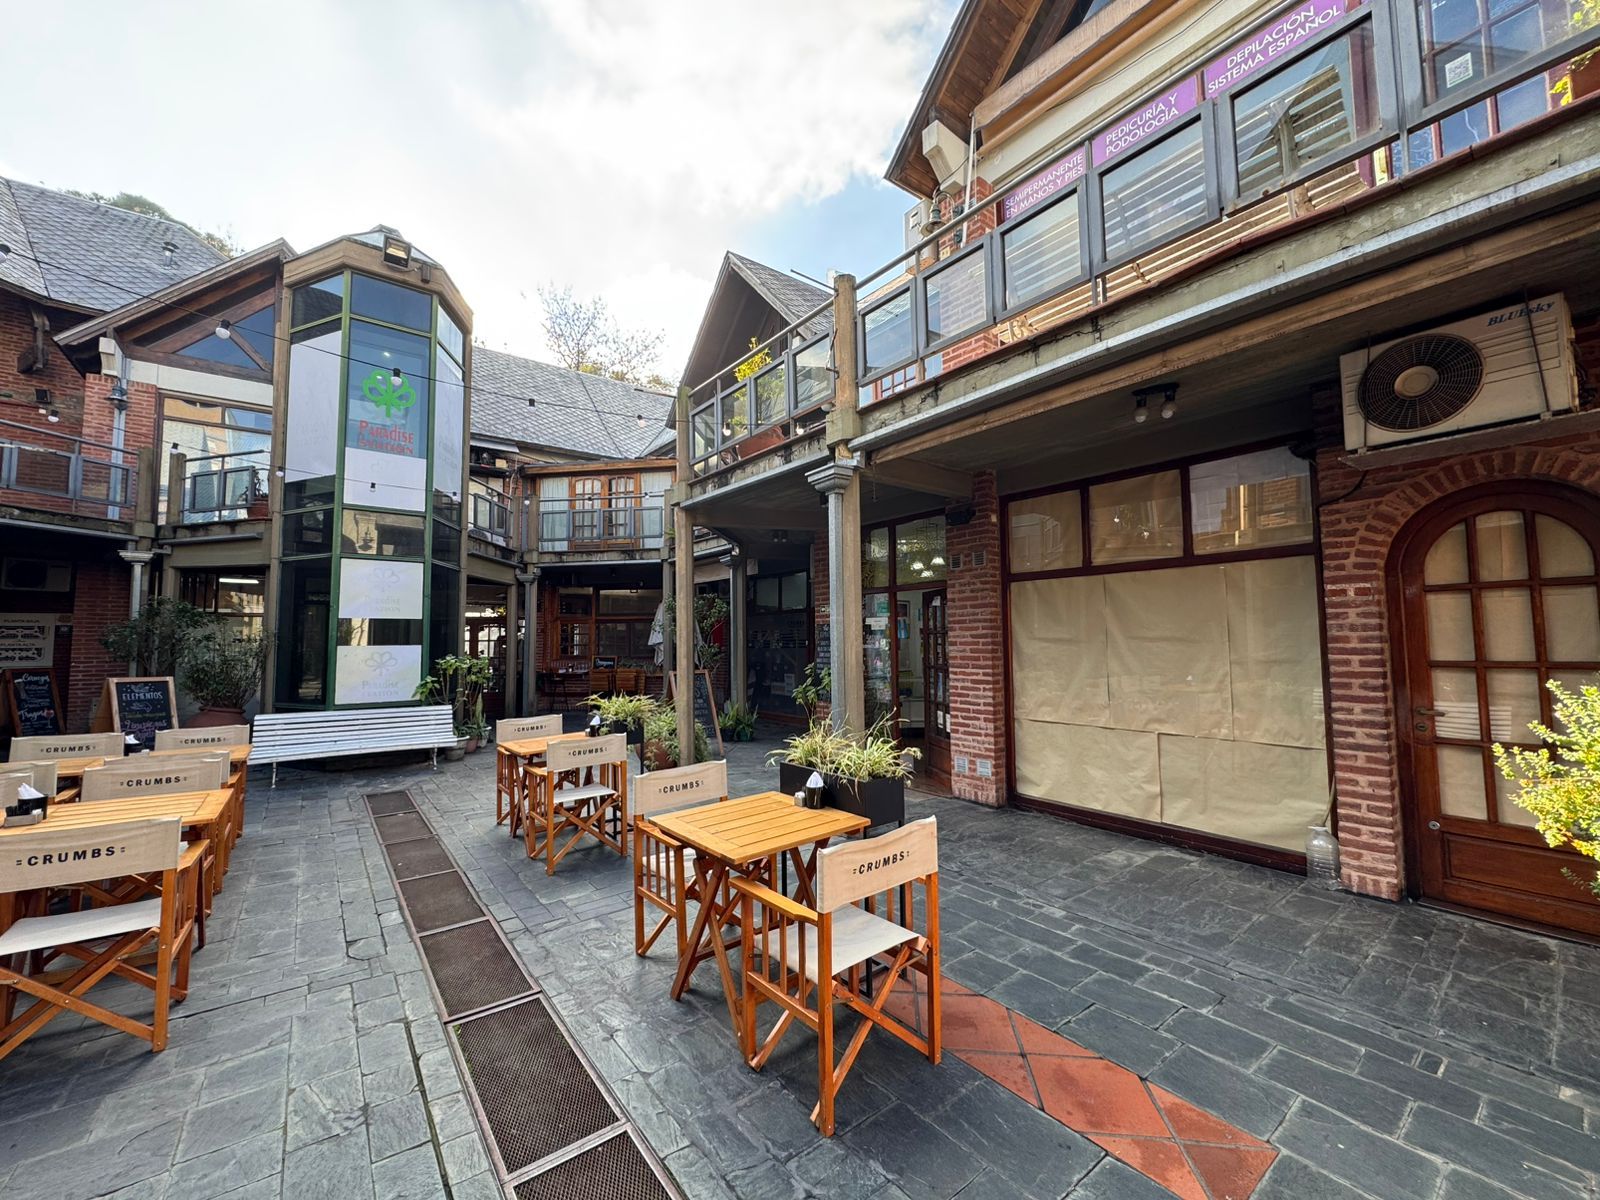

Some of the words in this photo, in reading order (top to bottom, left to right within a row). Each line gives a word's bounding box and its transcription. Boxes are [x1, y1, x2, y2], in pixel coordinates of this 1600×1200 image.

[1207, 53, 1265, 94] SISTEMA
[1268, 4, 1341, 57] ESPAÑOL
[1226, 4, 1315, 69] DEPILACIÓN
[1105, 102, 1166, 145] PEDICURÍA
[1168, 92, 1178, 105] Y
[1106, 106, 1179, 157] PODOLOGÍA
[1005, 152, 1083, 208] SEMIPERMANENTE
[1006, 204, 1018, 218] EN
[1019, 182, 1054, 210] MANOS
[1056, 177, 1063, 186] Y
[1064, 164, 1083, 182] PIES
